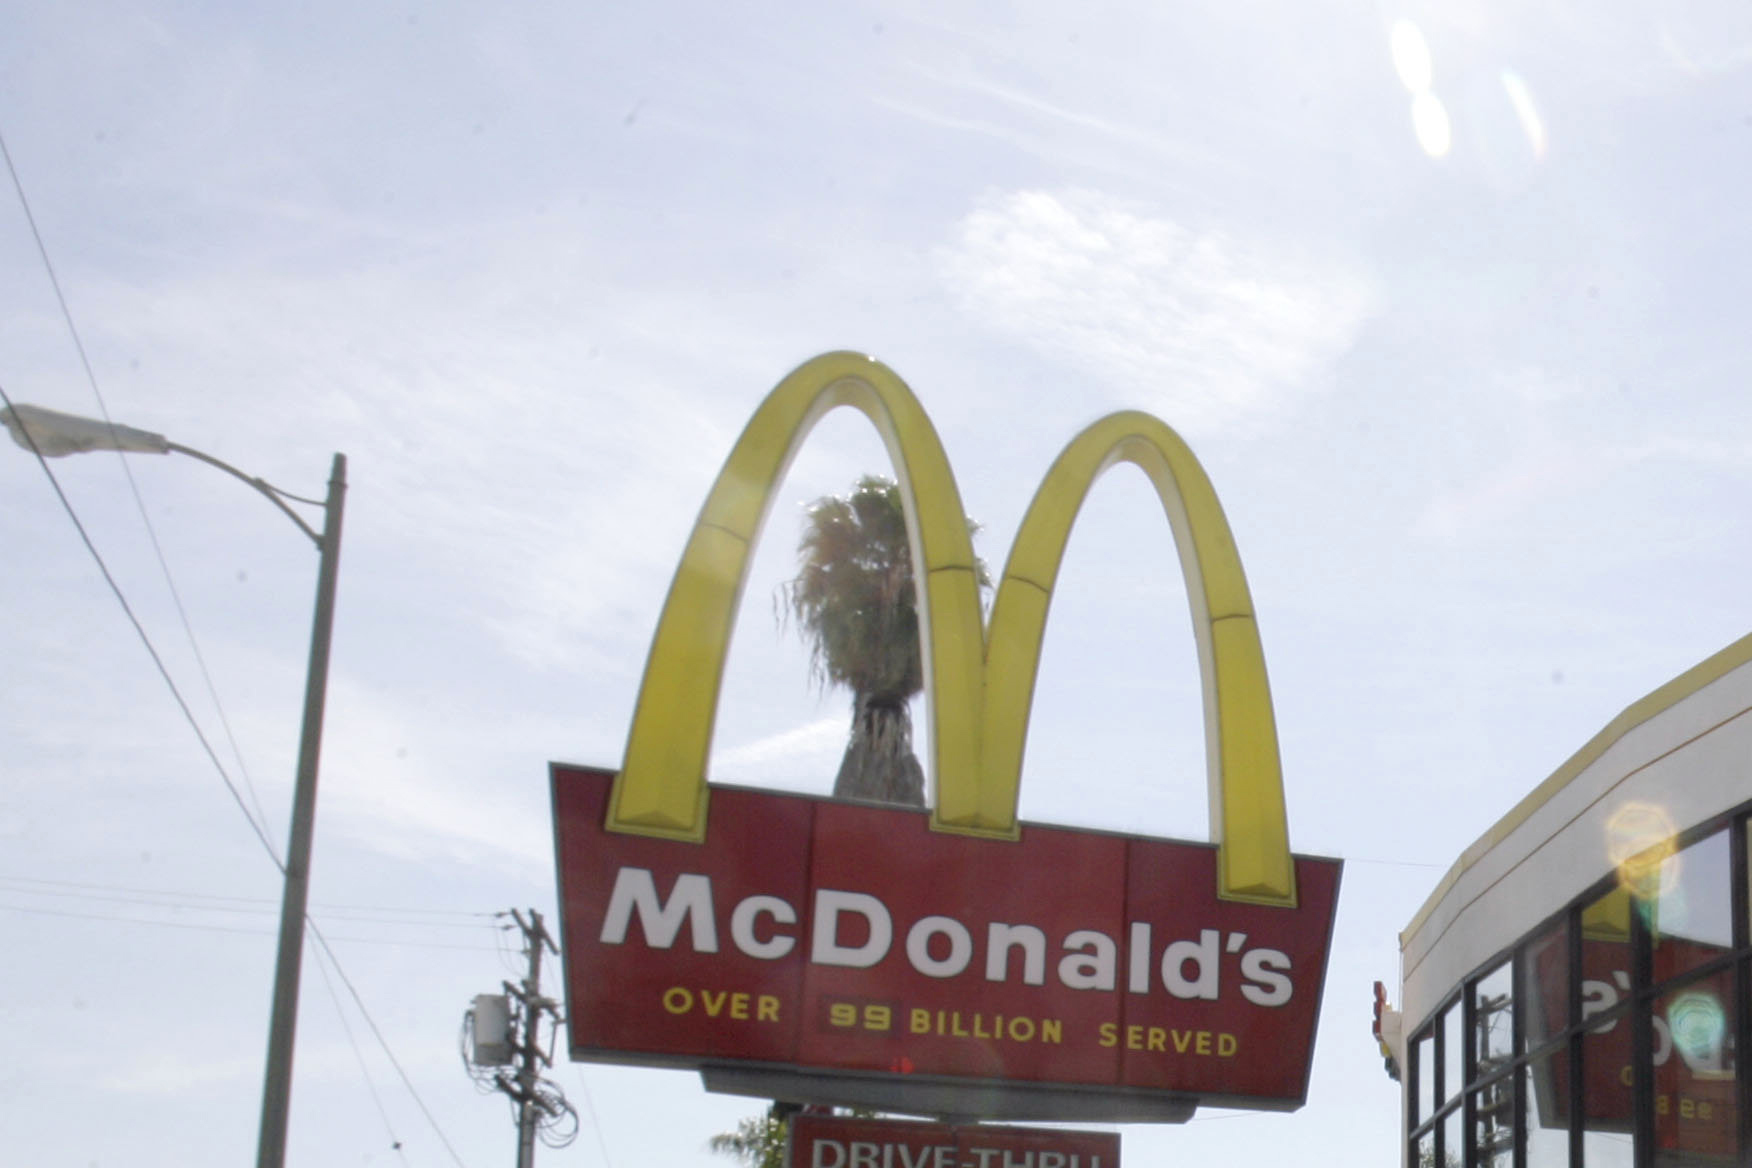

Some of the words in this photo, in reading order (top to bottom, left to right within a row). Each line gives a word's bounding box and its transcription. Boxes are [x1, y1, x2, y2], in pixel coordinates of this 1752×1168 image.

[599, 866, 1293, 1007] McDonald's
[662, 987, 781, 1023] OVER
[829, 1002, 892, 1032] 99
[910, 1008, 1063, 1044] BILLION
[1098, 1022, 1238, 1057] SERVED
